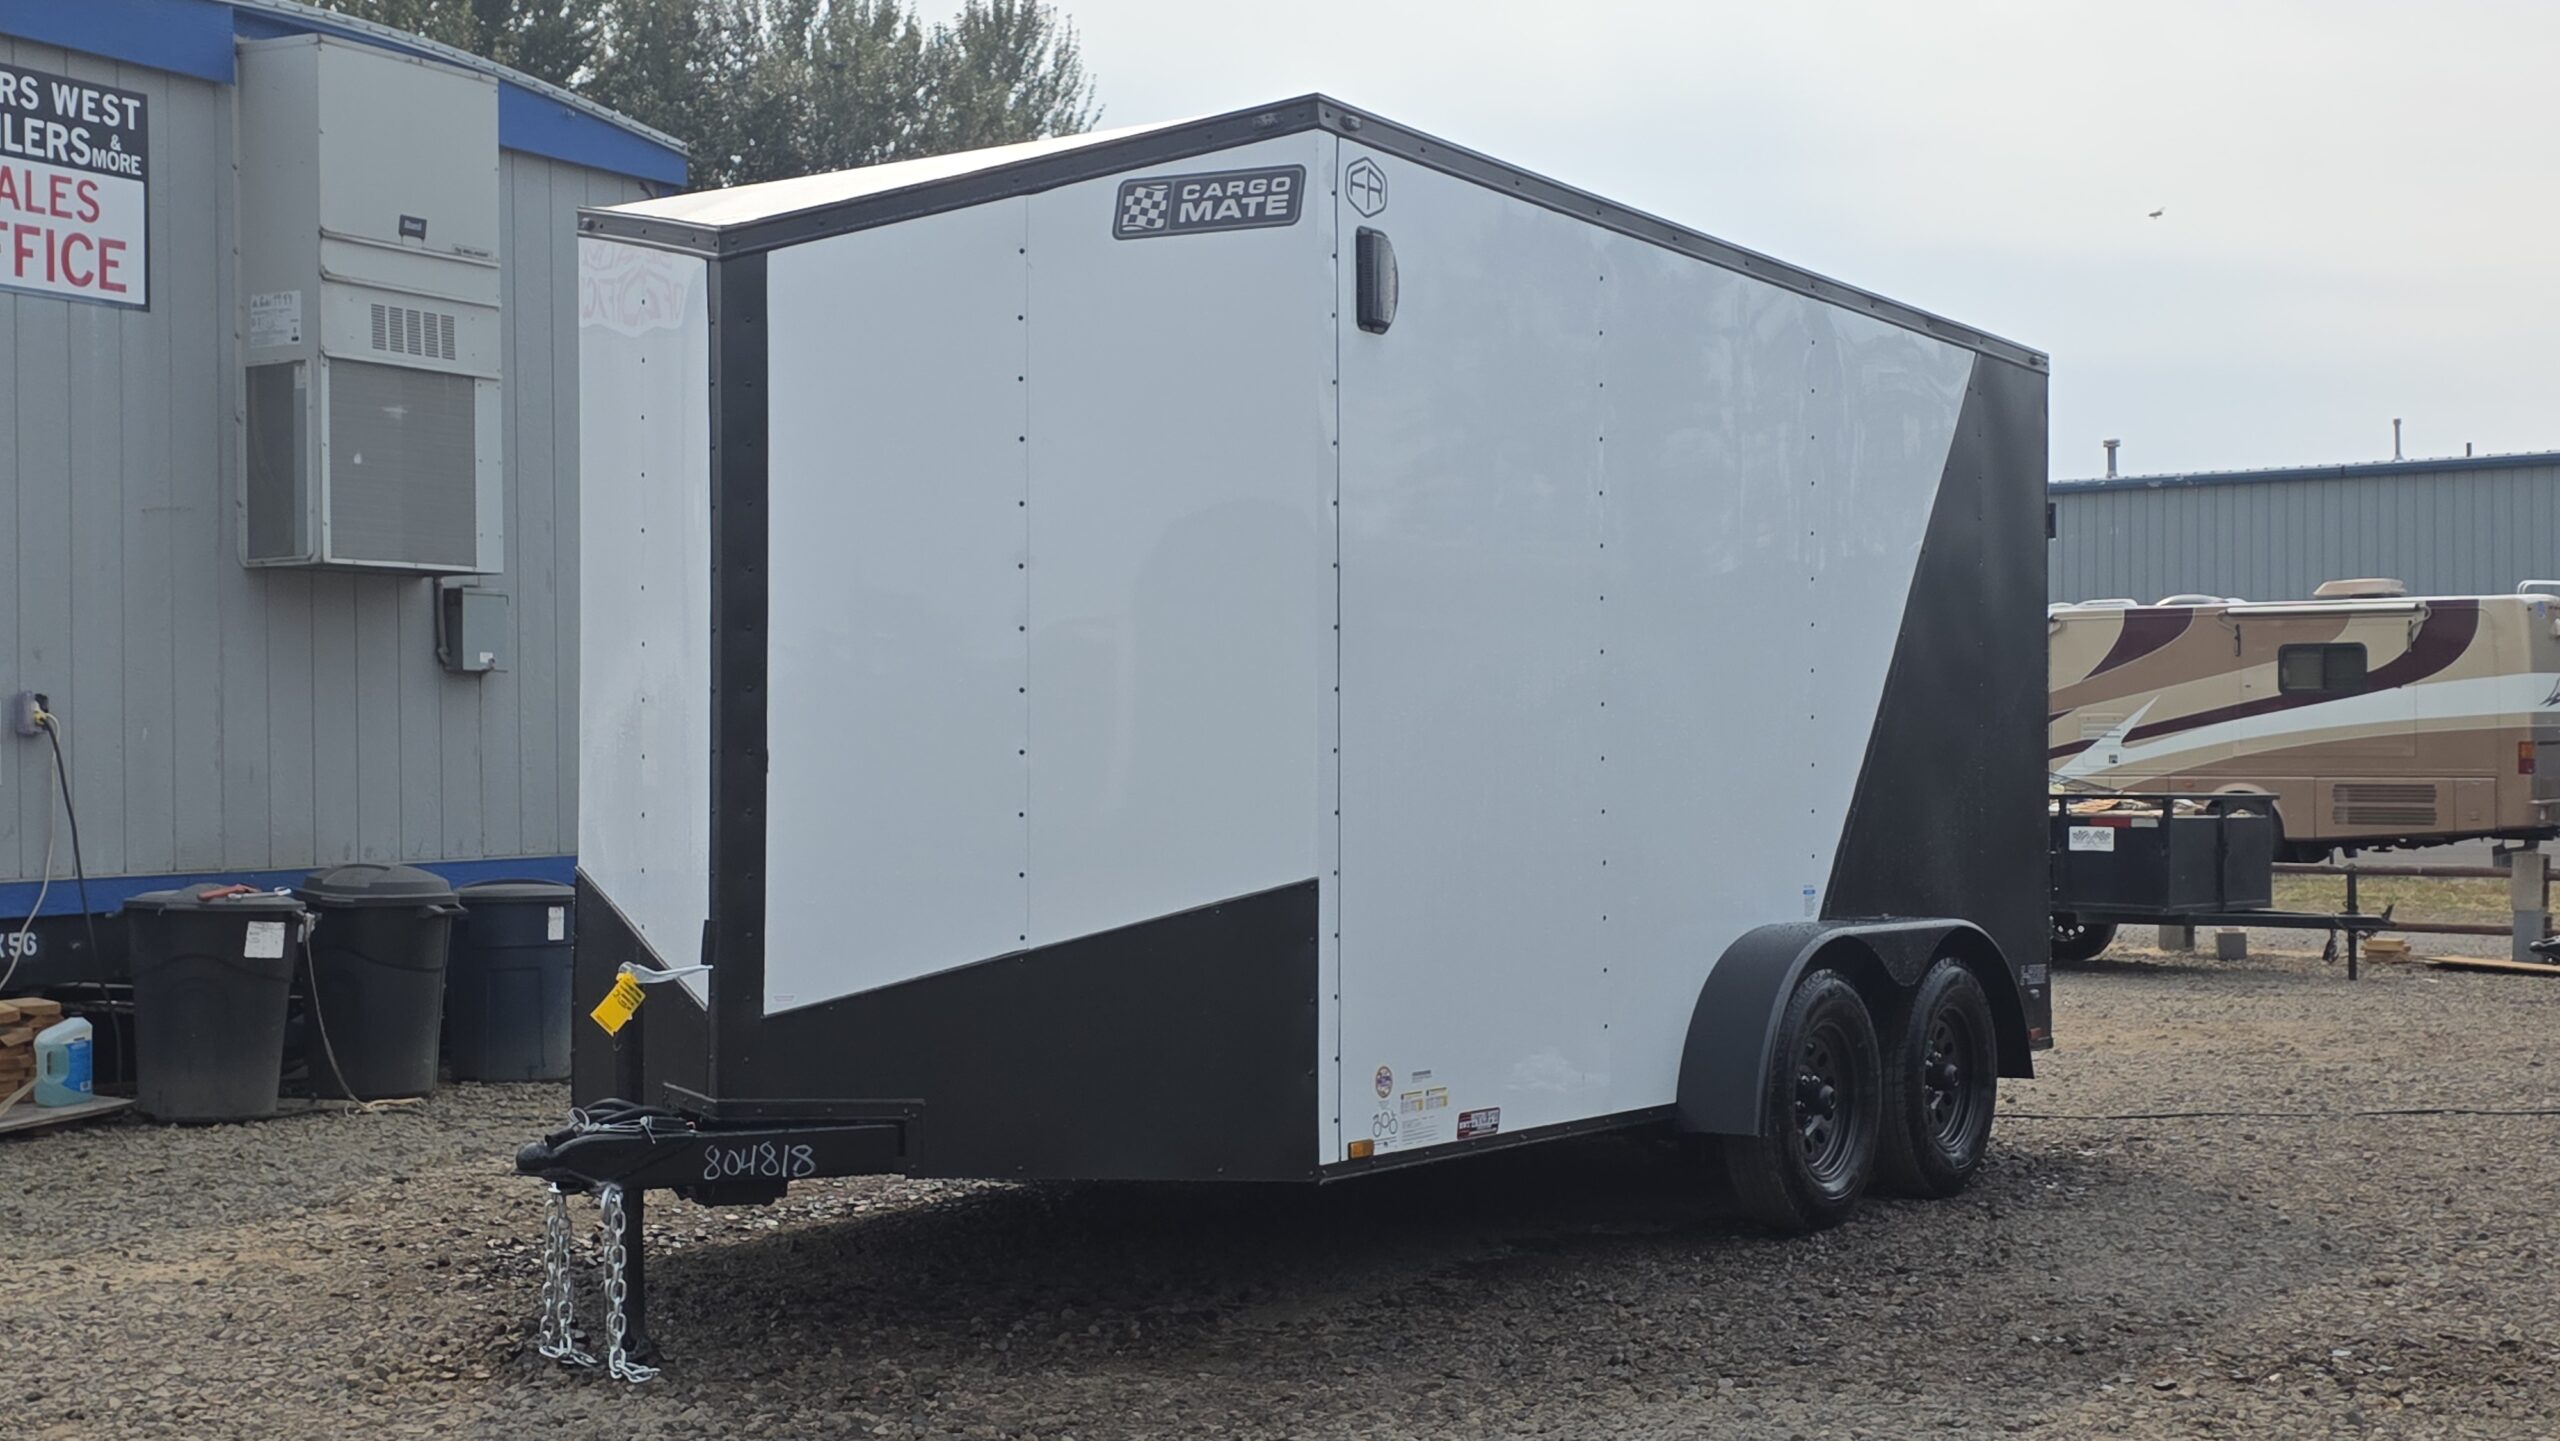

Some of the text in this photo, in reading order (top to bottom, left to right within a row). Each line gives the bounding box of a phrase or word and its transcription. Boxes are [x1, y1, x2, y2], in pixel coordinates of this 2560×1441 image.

[0, 70, 141, 131] RS WEST
[0, 111, 142, 175] LERS & MORE
[0, 165, 100, 223] ALES
[1179, 194, 1290, 223] MATE
[1182, 176, 1291, 200] CARGO
[703, 1141, 817, 1180] 804818
